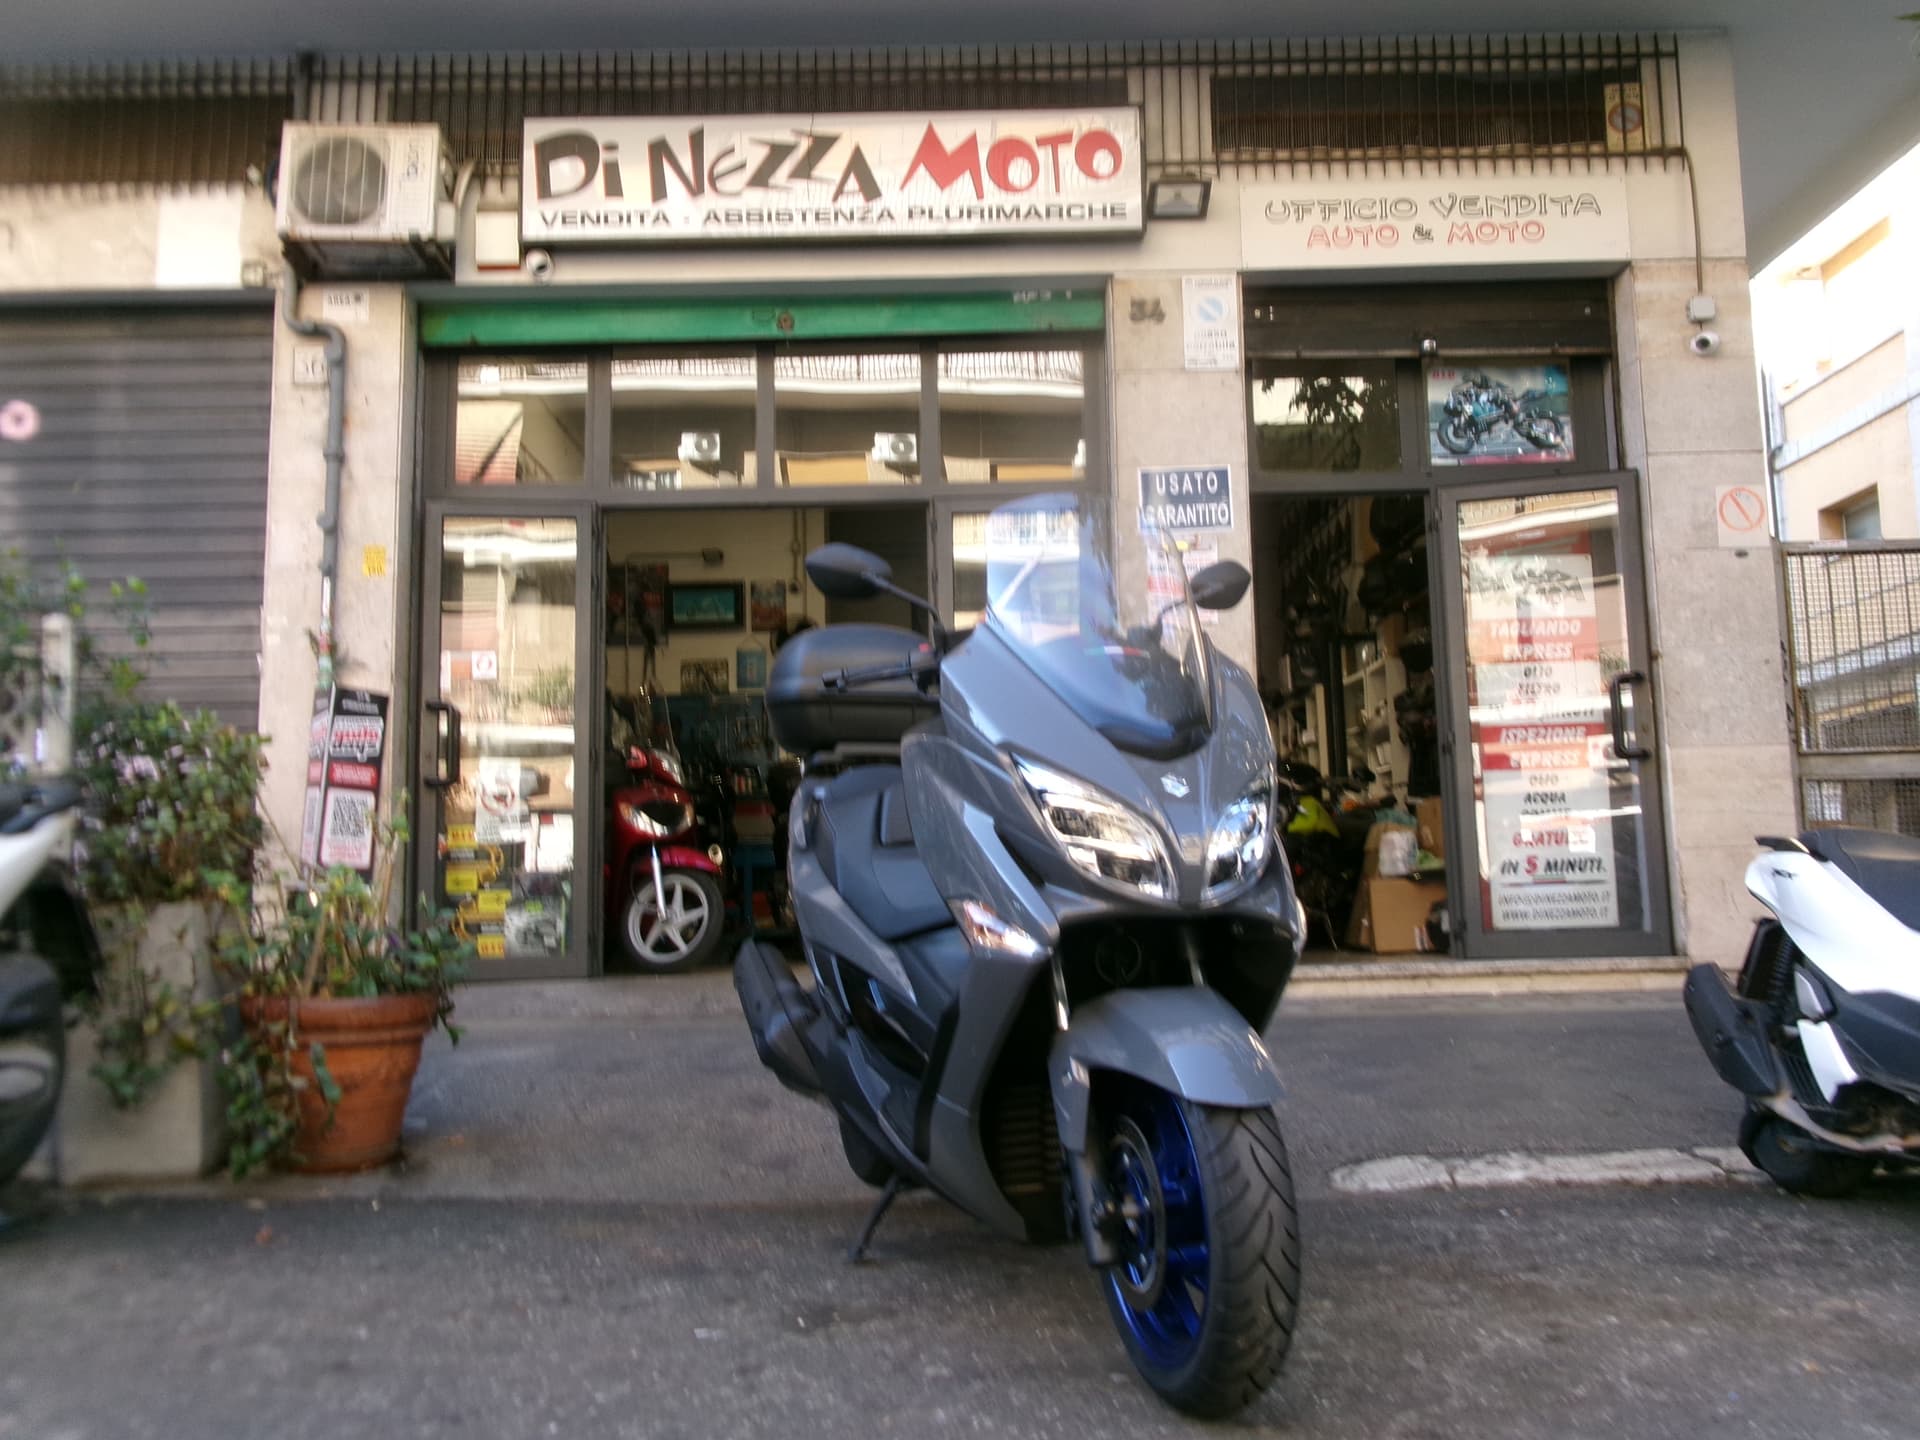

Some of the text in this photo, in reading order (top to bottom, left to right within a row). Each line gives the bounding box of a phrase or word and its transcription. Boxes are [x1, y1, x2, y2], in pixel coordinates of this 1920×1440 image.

[899, 121, 1123, 200] MOTO
[541, 203, 1128, 228] VENDITA ASSISTENZA PLURIMARCHE
[1265, 192, 1602, 223] UFFICIO VENDITA
[1307, 220, 1546, 248] AUTO & MOTO
[1155, 471, 1219, 497] USATO
[1499, 726, 1586, 745] ISPEZIONE
[1524, 791, 1567, 805] ACQUA
[1501, 858, 1520, 876] IN
[1525, 855, 1538, 875] 5
